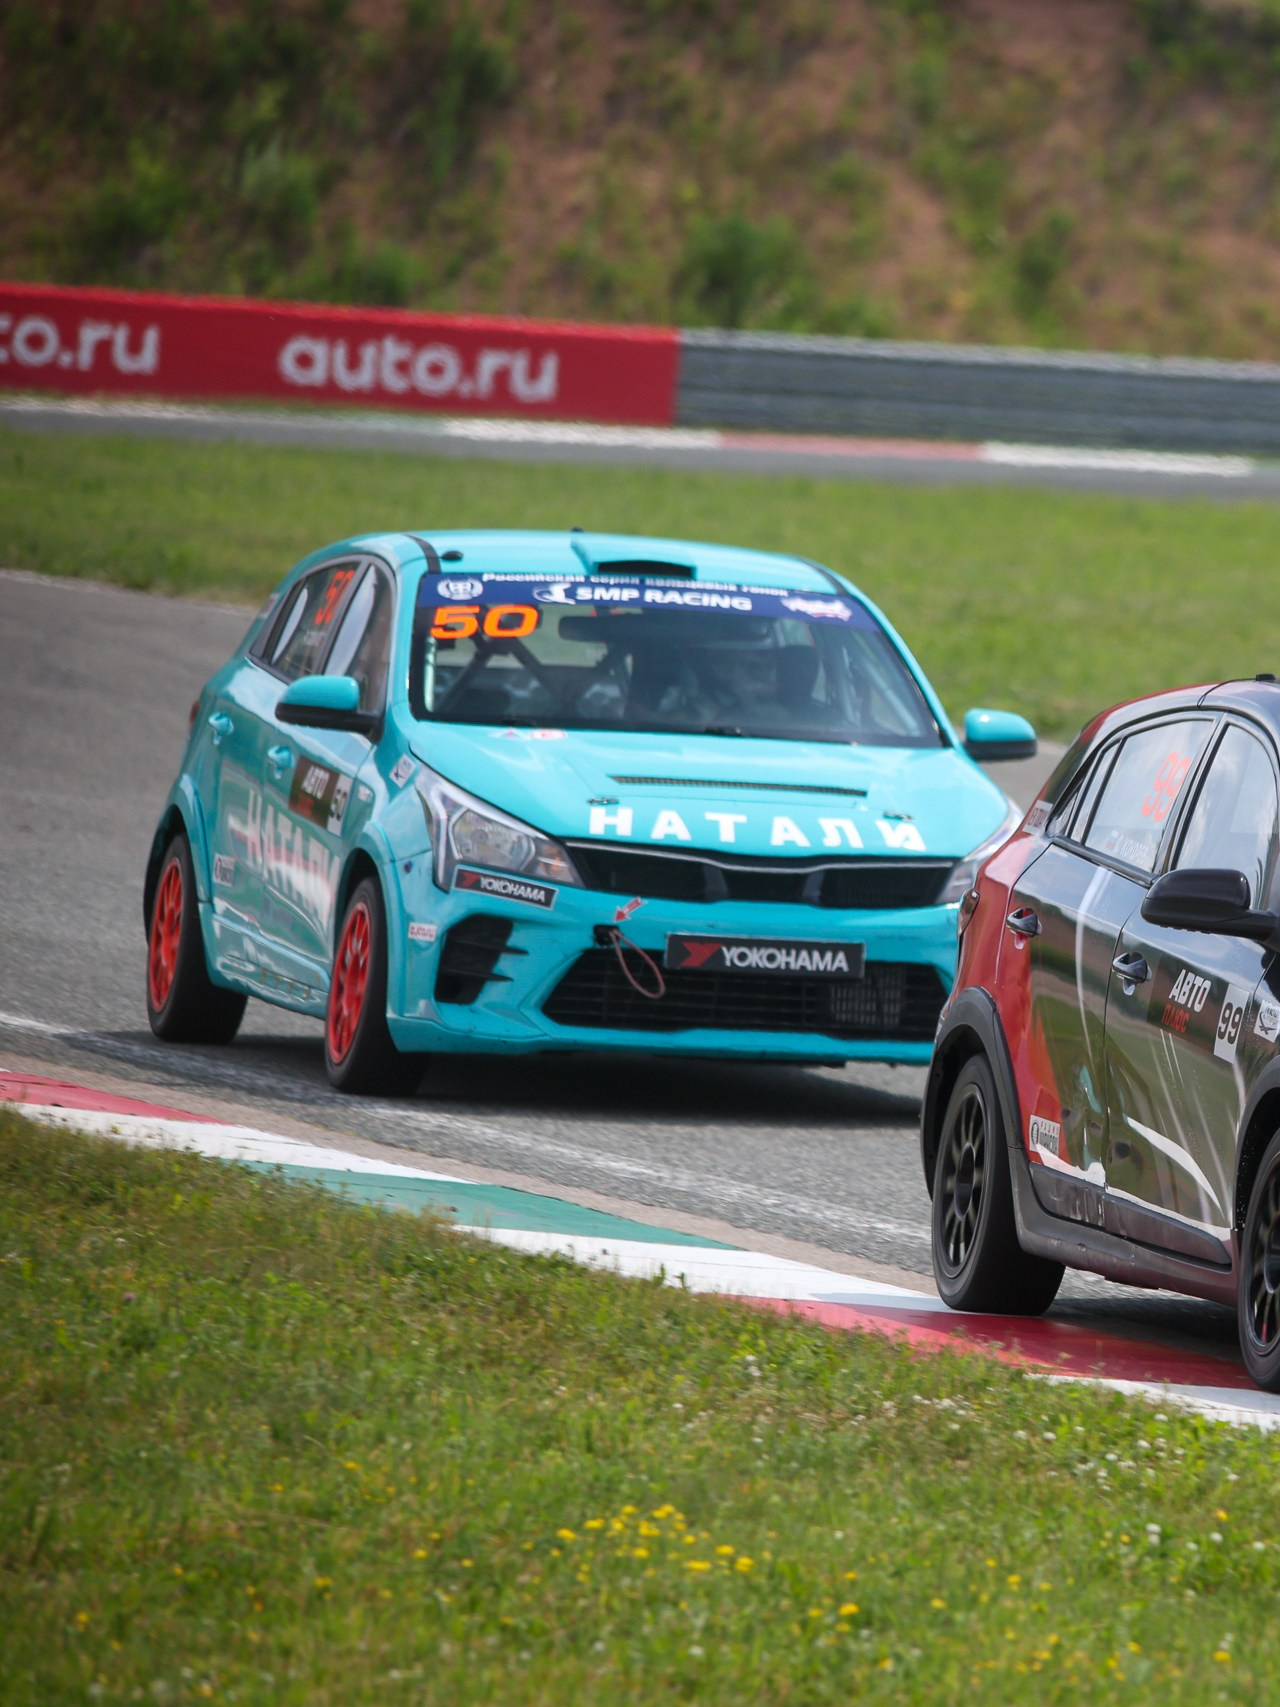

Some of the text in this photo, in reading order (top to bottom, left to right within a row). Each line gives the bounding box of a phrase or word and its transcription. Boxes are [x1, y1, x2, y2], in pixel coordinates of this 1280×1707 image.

[278, 333, 559, 401] auto.ru
[576, 587, 753, 611] SMP RACING
[430, 604, 539, 640] 50
[1141, 751, 1192, 824] 99
[589, 806, 927, 852] НАТАЛИ
[479, 876, 546, 903] YOKOHAMA
[721, 945, 850, 973] YOKOHAMA
[1168, 968, 1212, 1013] АВТО
[1217, 1002, 1244, 1045] 99
